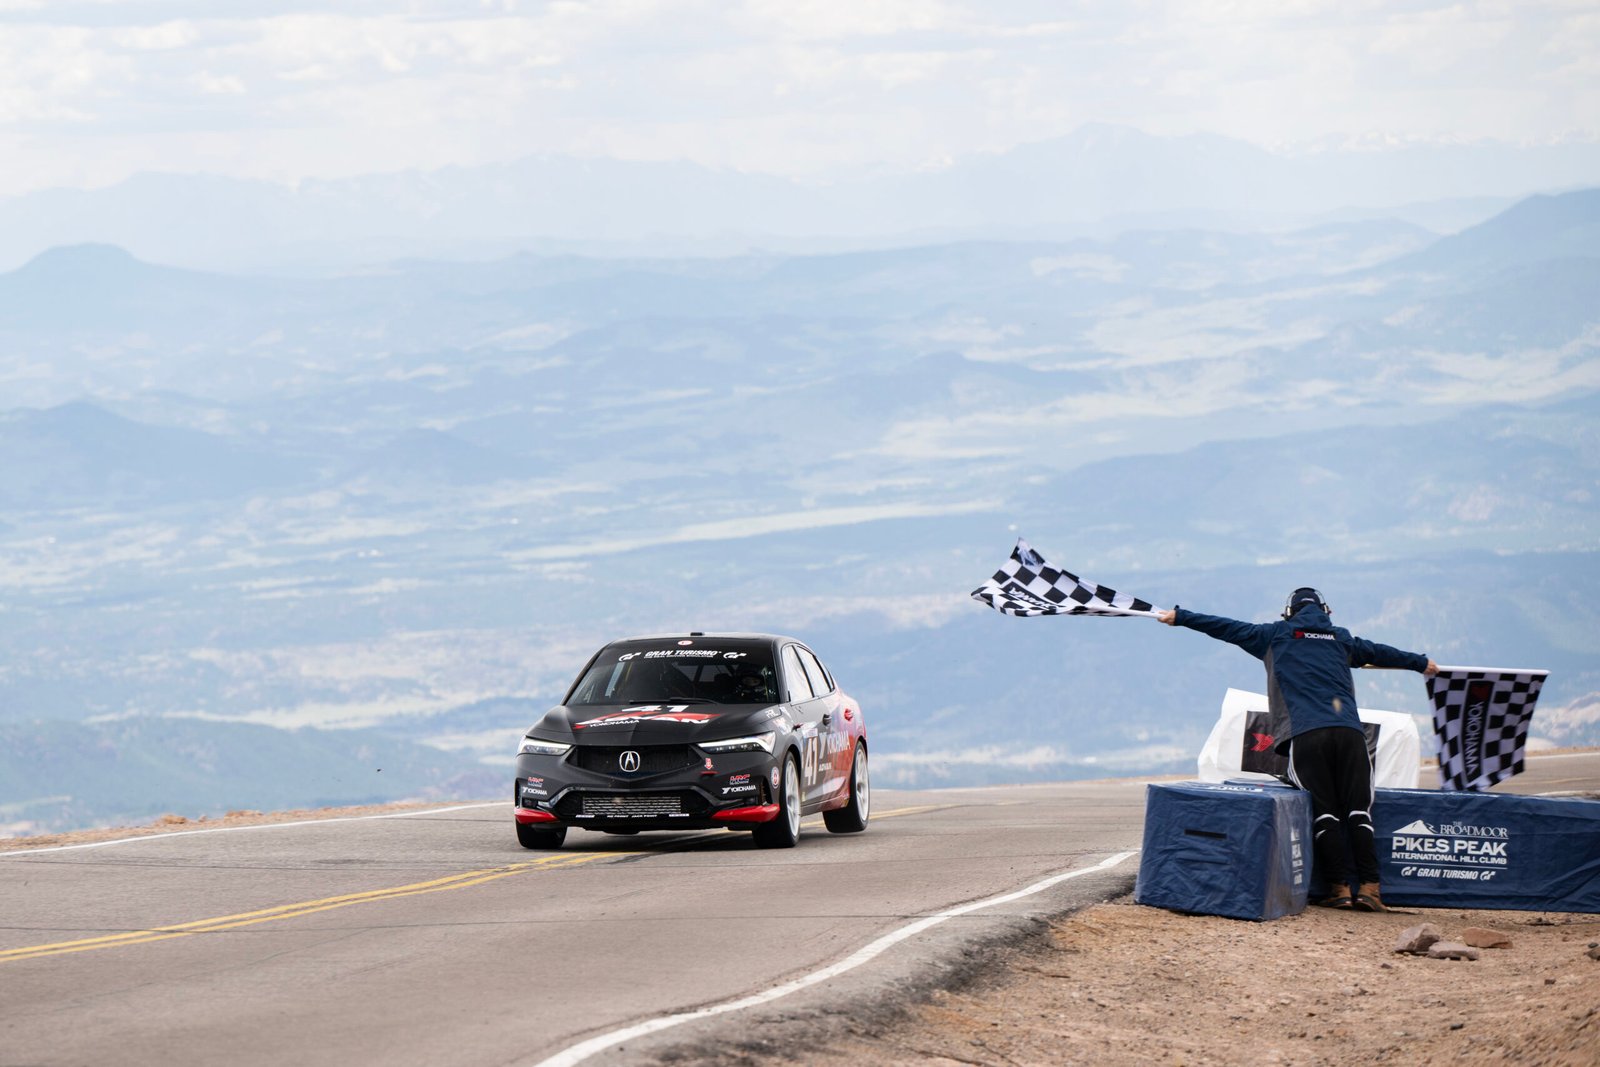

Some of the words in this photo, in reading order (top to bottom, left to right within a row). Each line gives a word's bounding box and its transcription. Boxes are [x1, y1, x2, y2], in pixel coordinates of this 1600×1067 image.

[1304, 632, 1336, 640] YOKOHAMA
[674, 649, 718, 657] TURISMO
[1465, 701, 1485, 775] YOKOHAMA
[804, 737, 818, 786] 41
[730, 785, 757, 793] YOKOHAMA
[1440, 824, 1508, 838] BROADMOOR
[1392, 836, 1450, 853] PIKES
[1454, 840, 1508, 856] PEAK
[1392, 852, 1458, 862] INTERNATIONAL
[1480, 857, 1507, 865] CLIMB
[1417, 868, 1441, 878] GRAN
[1442, 869, 1479, 880] TURISMO
